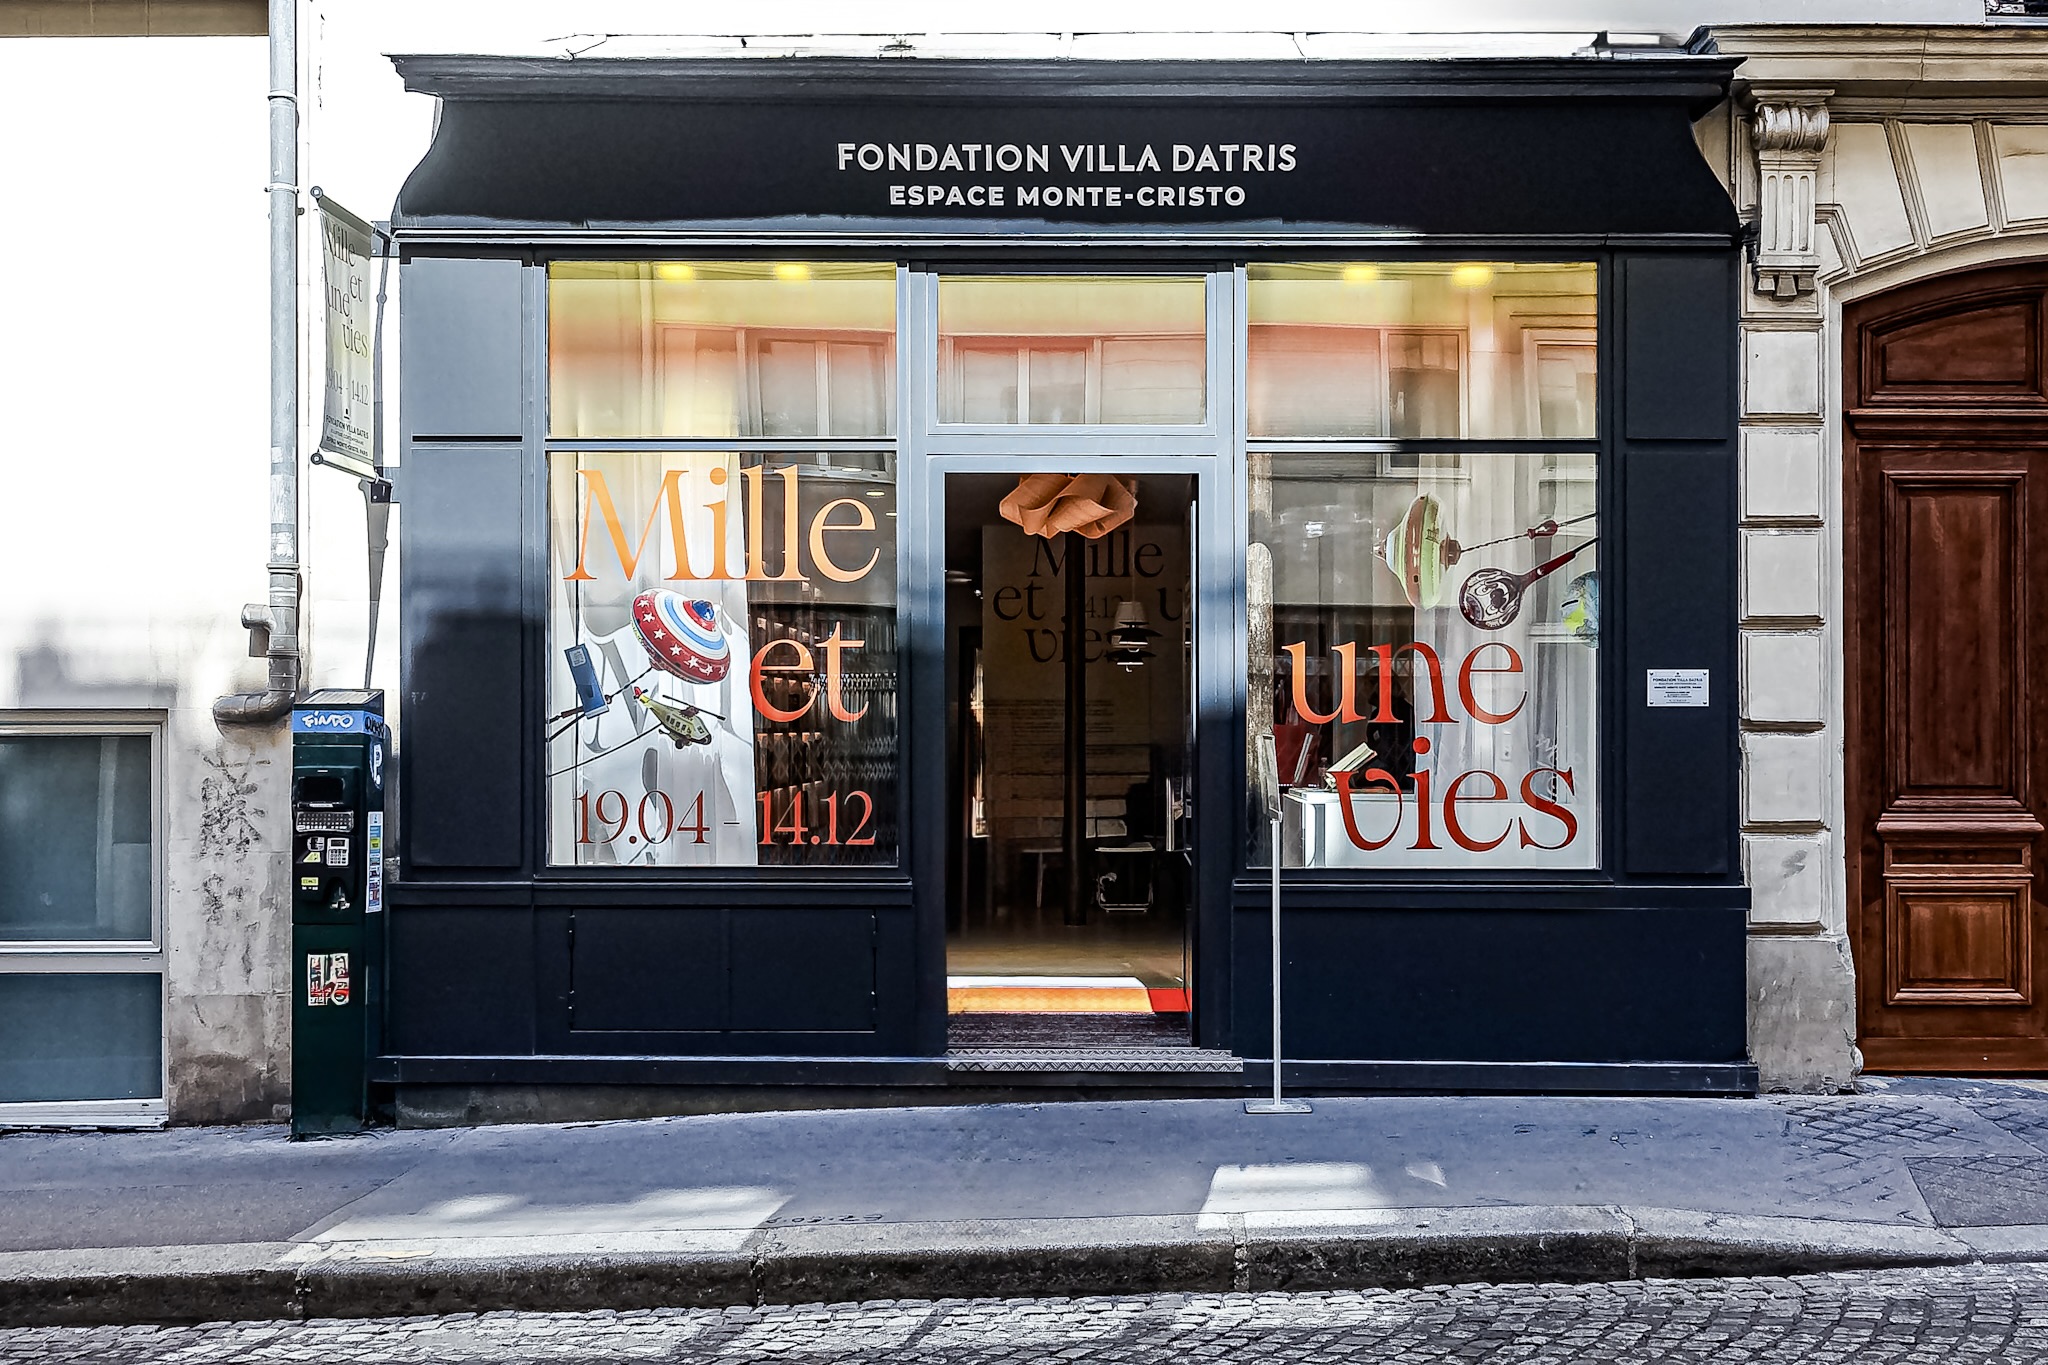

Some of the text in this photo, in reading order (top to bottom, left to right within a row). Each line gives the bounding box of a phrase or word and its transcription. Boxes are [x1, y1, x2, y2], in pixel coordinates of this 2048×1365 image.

[837, 143, 1297, 173] FONDATION VILLA DATRIS
[889, 185, 1246, 208] ESPACE MONTE-CRISTO
[326, 281, 351, 318] une
[349, 273, 363, 303] et
[563, 464, 880, 582] Mille
[992, 580, 1045, 621] et
[749, 622, 868, 722] et
[1281, 641, 1527, 725] une
[573, 790, 711, 845] 19.04
[756, 790, 876, 846] 14.12
[1327, 736, 1579, 852] vies
